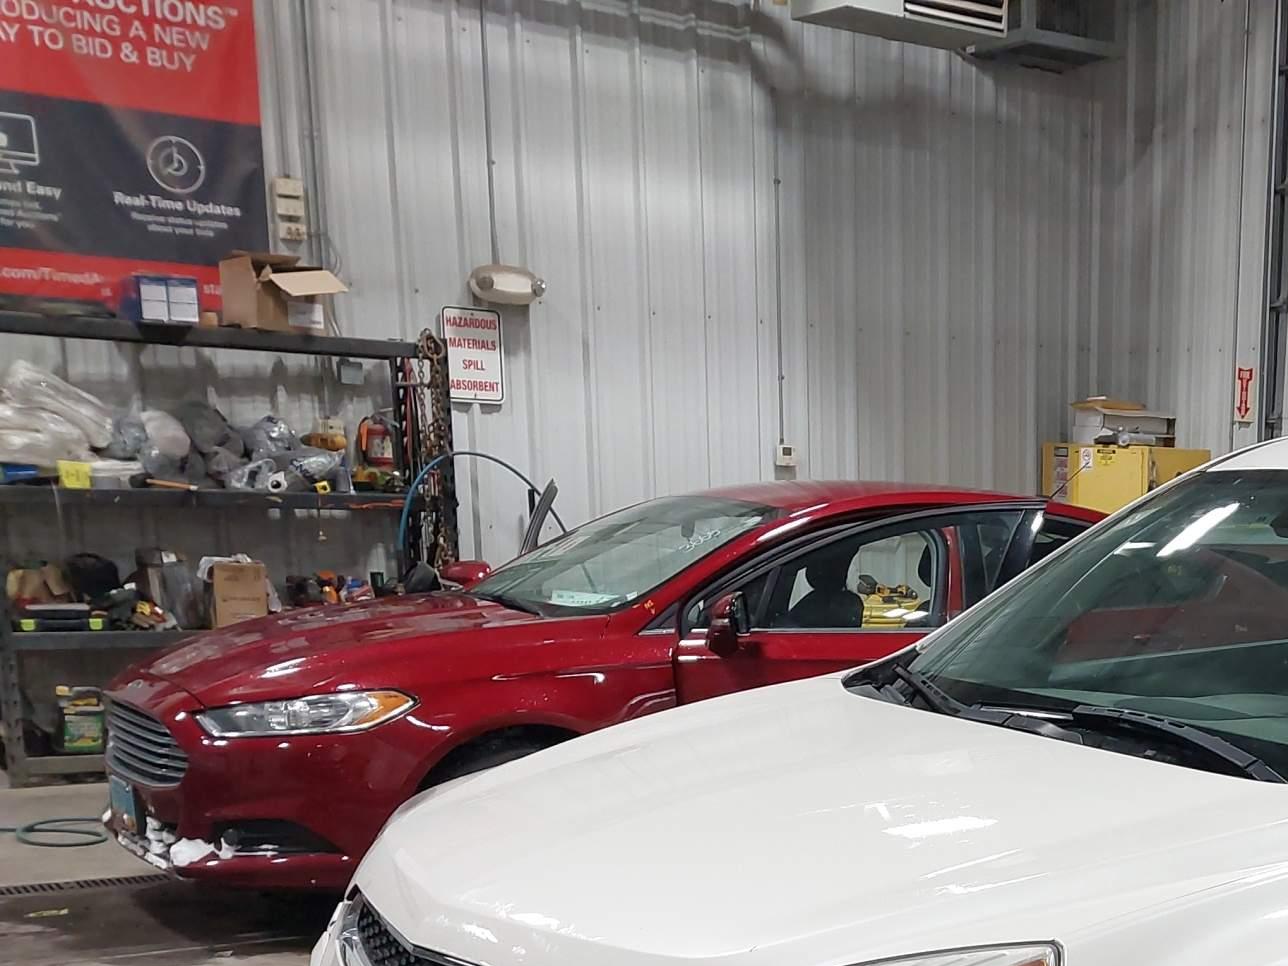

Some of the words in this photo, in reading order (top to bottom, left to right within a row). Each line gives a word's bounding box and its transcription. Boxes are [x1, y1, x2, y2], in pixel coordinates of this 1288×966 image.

[129, 20, 147, 41] A
[153, 23, 210, 51] NEW
[27, 25, 64, 51] TO
[71, 33, 113, 59] BID
[120, 41, 139, 64] &
[146, 46, 197, 72] BUY
[26, 181, 62, 200] Easy
[112, 191, 184, 212] Real-Time
[186, 199, 242, 217] Updates
[446, 316, 497, 330] HAZARDOUS
[449, 337, 497, 352] MATERIALS
[462, 359, 486, 371] SPILL
[450, 379, 500, 393] ABSORBENT
